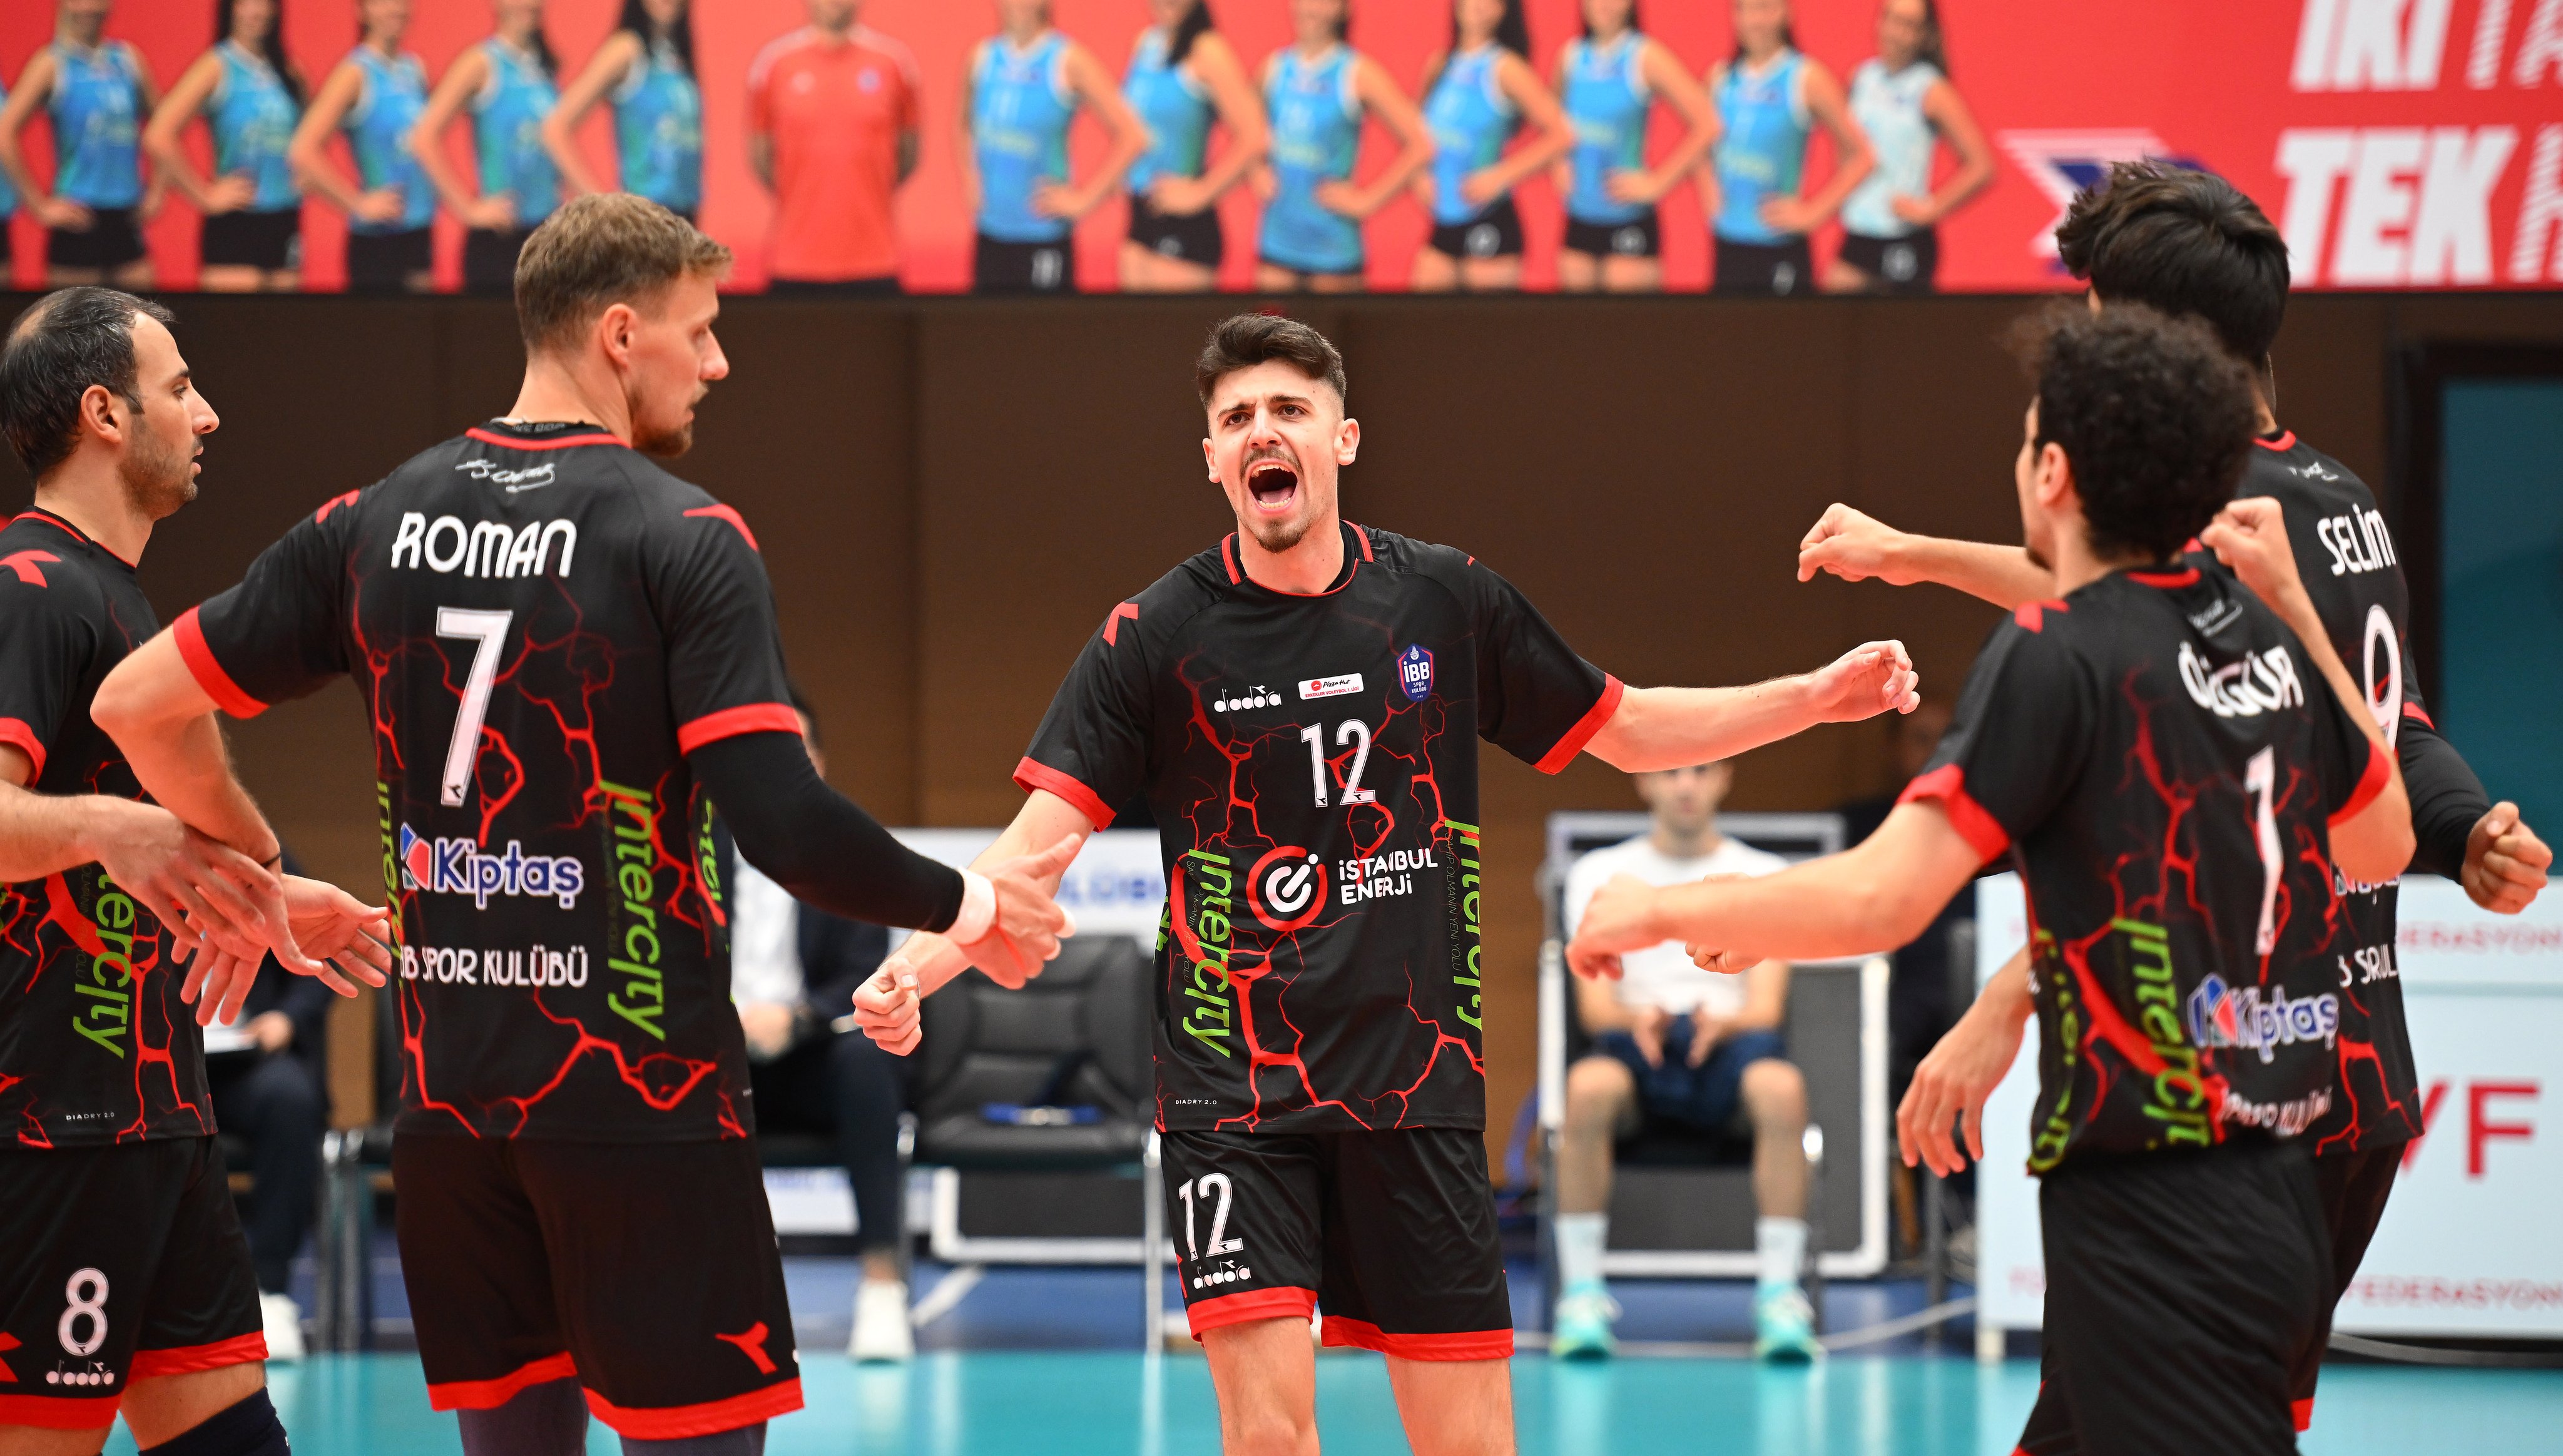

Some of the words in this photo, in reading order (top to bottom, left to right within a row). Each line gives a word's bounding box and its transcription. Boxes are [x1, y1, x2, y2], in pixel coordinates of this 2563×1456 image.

[2273, 125, 2520, 288] TEK
[391, 512, 577, 578] ROMAN
[2317, 502, 2396, 576] SELİM
[436, 606, 513, 807] 7
[1214, 685, 1282, 713] diadora
[2363, 603, 2402, 753] 9
[1300, 718, 1376, 808] 12
[435, 837, 583, 909] Kiptaş
[2245, 745, 2283, 955] 1
[1446, 866, 1457, 915] OLMANIN
[483, 945, 588, 987] KULÜBÜ
[1183, 955, 1191, 983] YOLU
[1451, 943, 1462, 971] YOLU
[1179, 1173, 1244, 1261] 12
[1193, 1260, 1251, 1290] diadora
[58, 1268, 109, 1356] 8
